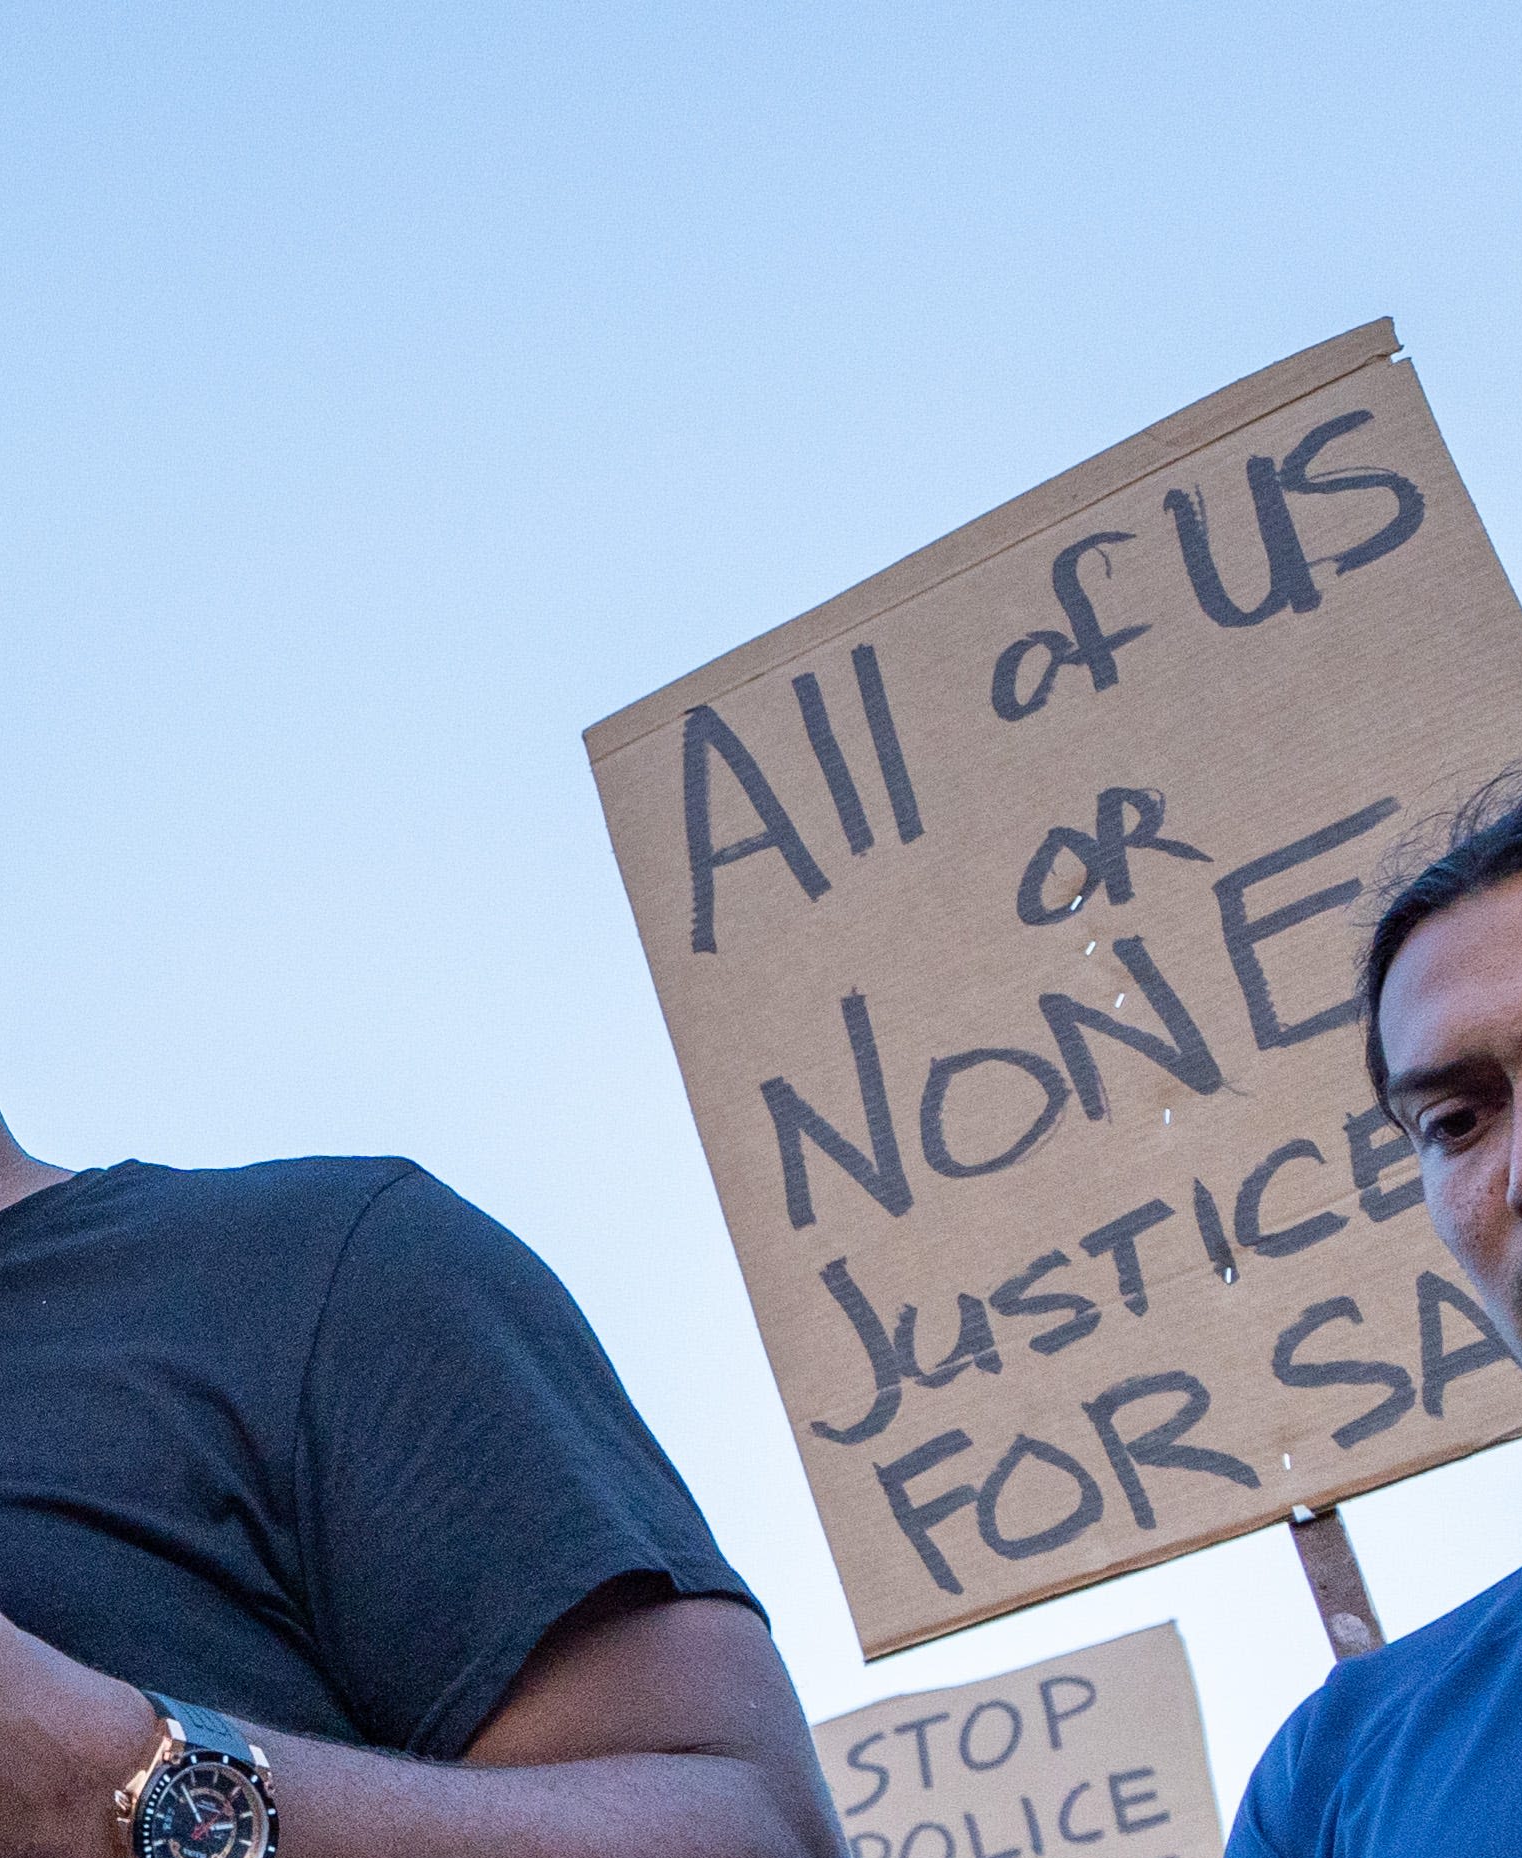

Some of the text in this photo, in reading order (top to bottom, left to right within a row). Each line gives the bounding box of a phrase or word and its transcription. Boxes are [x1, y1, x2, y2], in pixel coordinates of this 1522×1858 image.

[683, 409, 1425, 954] All of US
[760, 798, 1399, 1230] NONE
[1015, 786, 1214, 926] OR
[873, 1268, 1514, 1595] FOR SA
[845, 1675, 1097, 1817] STOP
